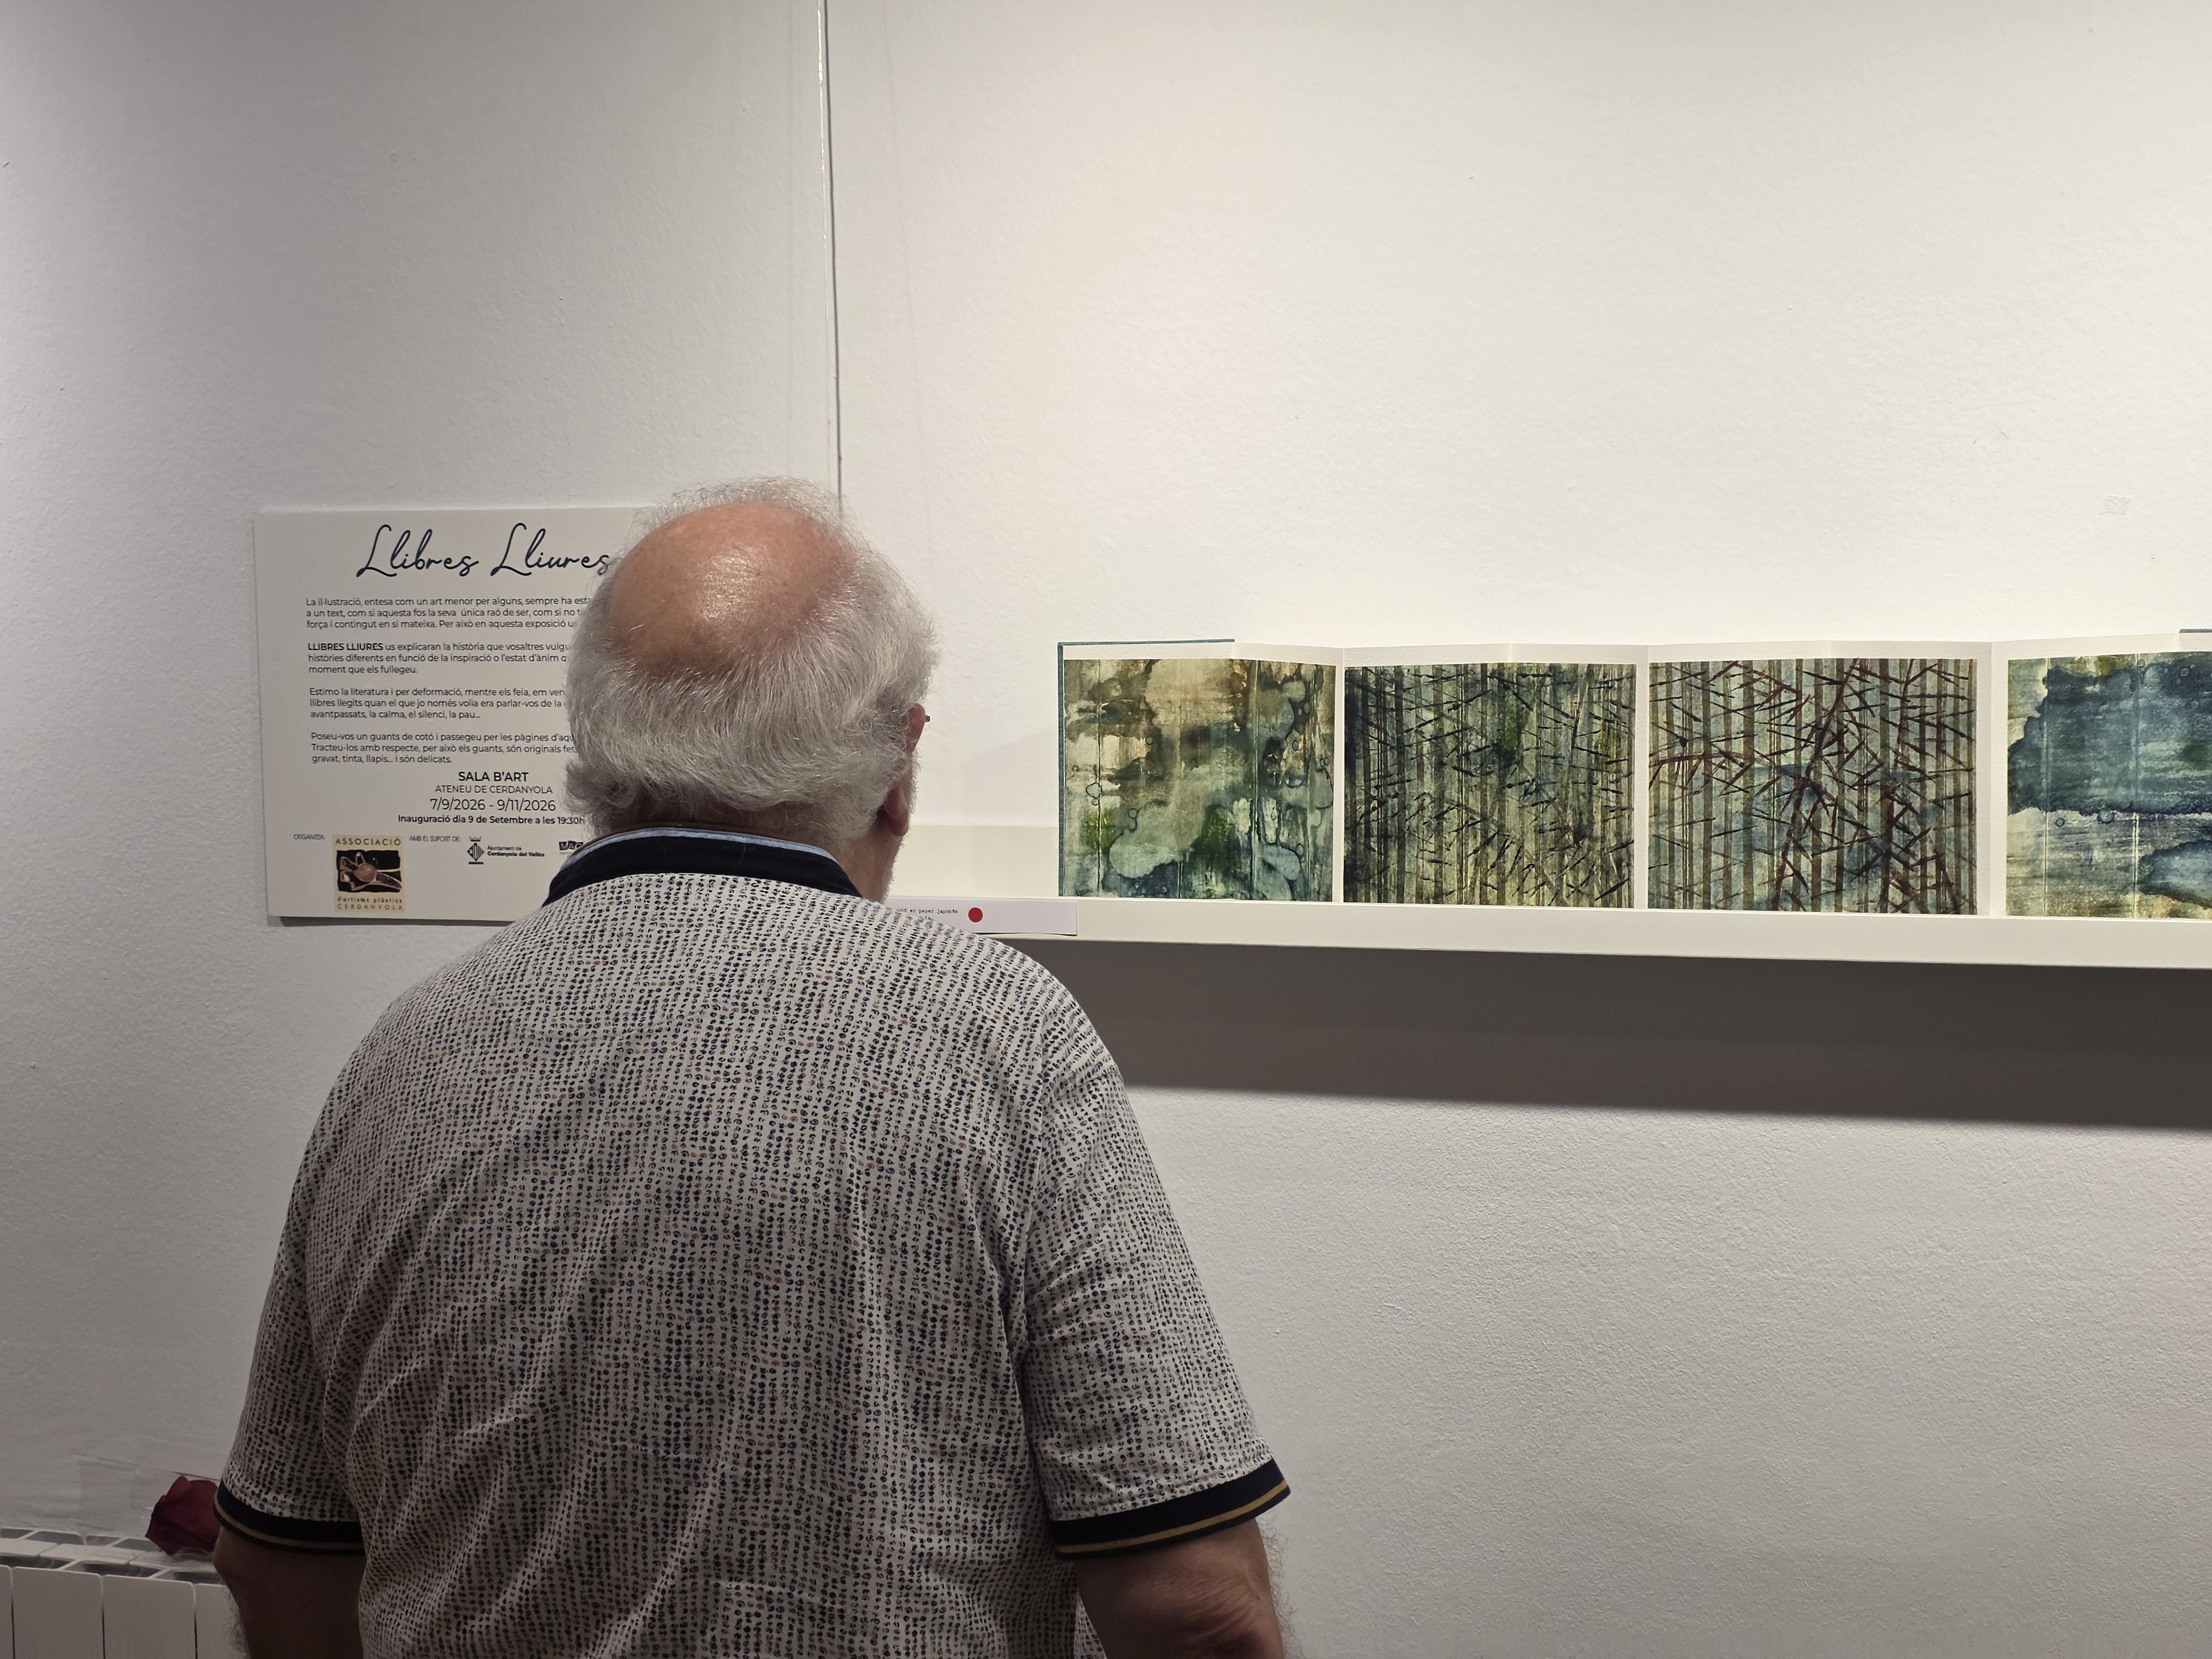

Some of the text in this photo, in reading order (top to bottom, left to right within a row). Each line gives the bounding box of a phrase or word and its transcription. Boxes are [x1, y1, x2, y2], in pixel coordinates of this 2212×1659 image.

[356, 523, 609, 577] Llibres Lliures
[492, 597, 523, 606] alguns,
[555, 608, 561, 616] si
[307, 620, 328, 630] força
[335, 620, 377, 630] contingut
[489, 621, 523, 629] aquesta
[525, 619, 566, 629] exposició
[398, 643, 441, 652] explicaran
[545, 643, 570, 652] vulgu
[309, 654, 344, 662] històries
[451, 654, 492, 663] inspiració
[380, 665, 418, 675] fullegeu.
[412, 688, 462, 697] deformació,
[513, 688, 530, 697] feia,
[337, 699, 363, 708] llegits
[416, 699, 425, 708] jo
[497, 700, 539, 709] parlar-vos
[311, 711, 367, 719] avantpassats,
[379, 711, 406, 719] calma,
[418, 710, 447, 719] silenci,
[515, 733, 549, 743] pàgines
[551, 733, 573, 742] d'aqu
[472, 745, 504, 754] guants,
[524, 745, 561, 754] originals
[563, 744, 576, 753] fet
[342, 754, 364, 763] tinta,
[458, 771, 490, 781] SALA
[489, 785, 553, 794] CERDANYOLA
[430, 796, 485, 811] 7/9/2026
[497, 797, 556, 812] 9/11/2026
[398, 815, 450, 824] Inauguració
[335, 837, 401, 846] ASSOCIACIÓ
